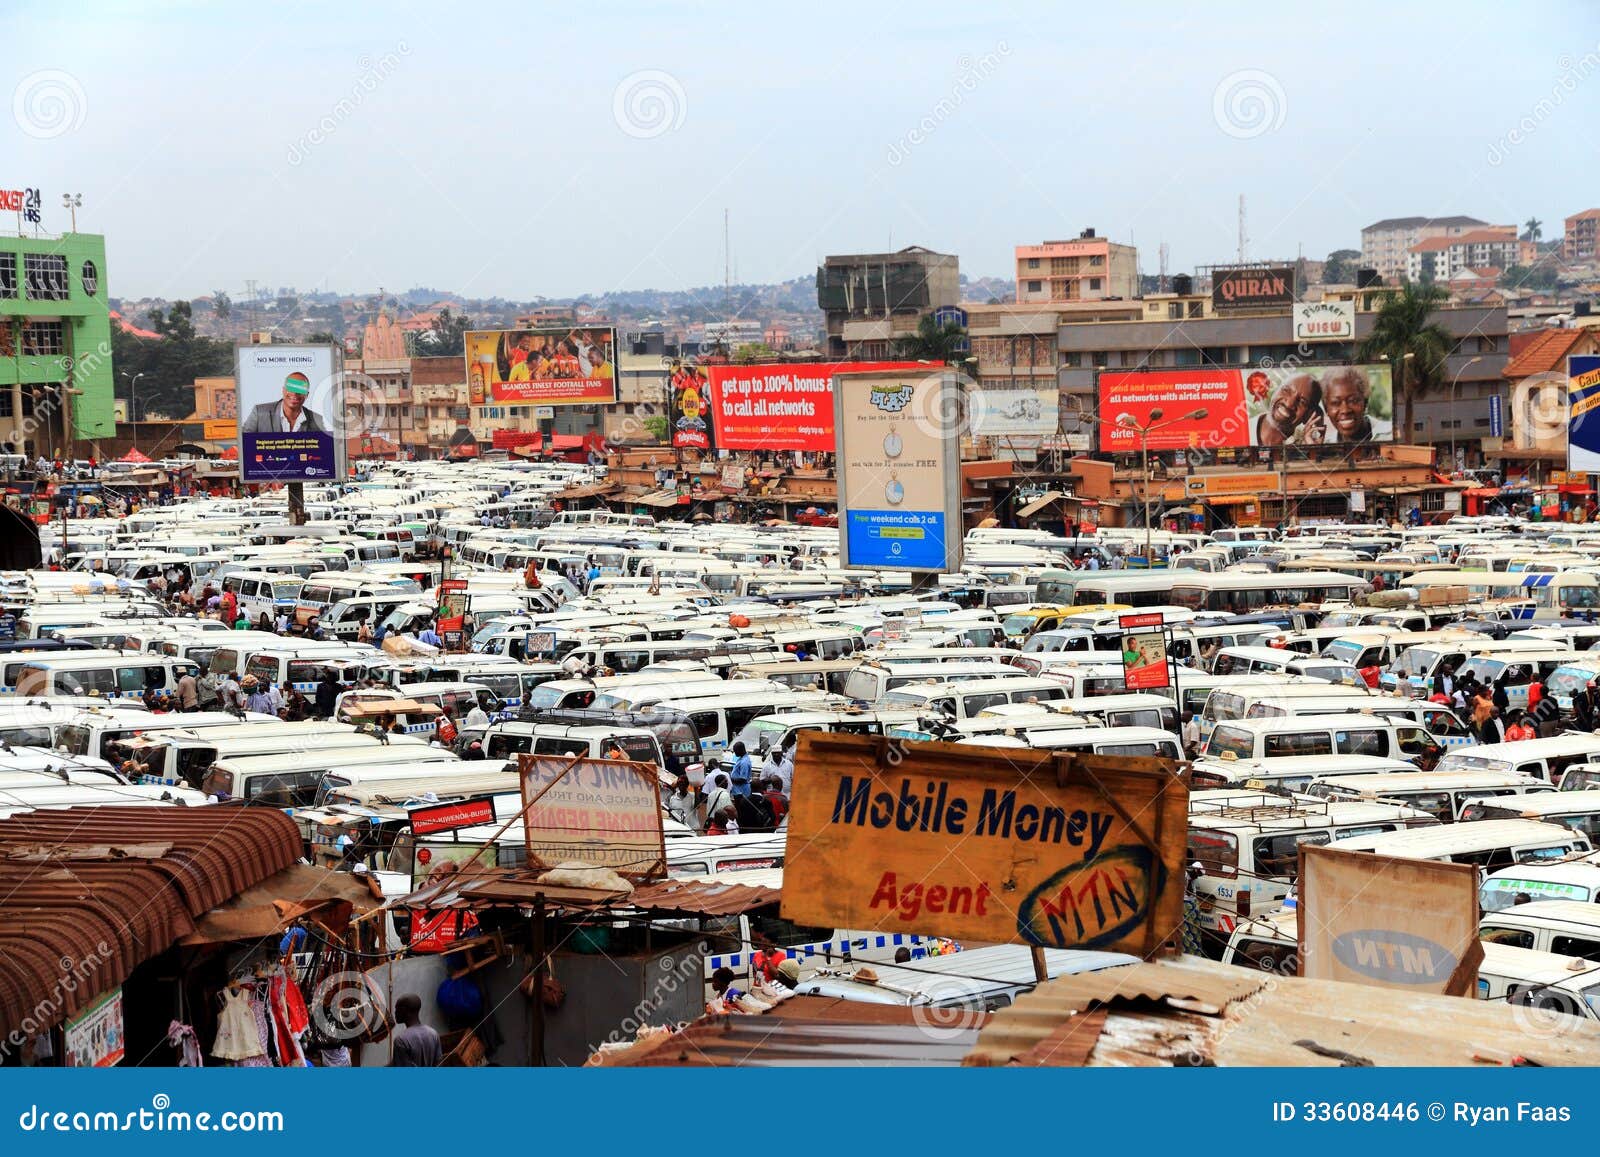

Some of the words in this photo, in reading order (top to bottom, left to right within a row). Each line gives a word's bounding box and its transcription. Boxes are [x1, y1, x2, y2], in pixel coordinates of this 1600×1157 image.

[25, 188, 41, 208] 24
[23, 208, 41, 222] HRS
[1221, 278, 1285, 301] QURAN
[553, 381, 585, 389] FOOTBALL
[721, 377, 737, 398] get
[738, 379, 751, 398] up
[751, 377, 762, 392] to
[763, 375, 793, 392] 100%
[793, 374, 825, 392] bonus
[1110, 383, 1128, 392] send
[1130, 383, 1145, 392] and
[1146, 382, 1174, 391] receive
[1175, 383, 1201, 391] money
[1202, 382, 1228, 390] across
[870, 385, 914, 412] BLAST
[1109, 395, 1121, 403] all
[1122, 393, 1159, 403] networks
[1160, 393, 1178, 401] with
[1178, 392, 1201, 401] airtel
[1201, 392, 1228, 401] money
[722, 400, 734, 416] to
[734, 399, 753, 416] call
[753, 399, 767, 416] all
[768, 398, 815, 416] networks
[1110, 428, 1134, 439] airtel
[870, 515, 903, 523] weekend
[903, 515, 920, 523] calls
[921, 515, 926, 524] 2
[832, 775, 968, 835] Mobile
[975, 788, 1115, 860] Money
[870, 871, 991, 922] Agent
[1217, 887, 1233, 898] 153J
[1040, 866, 1140, 946] MTN
